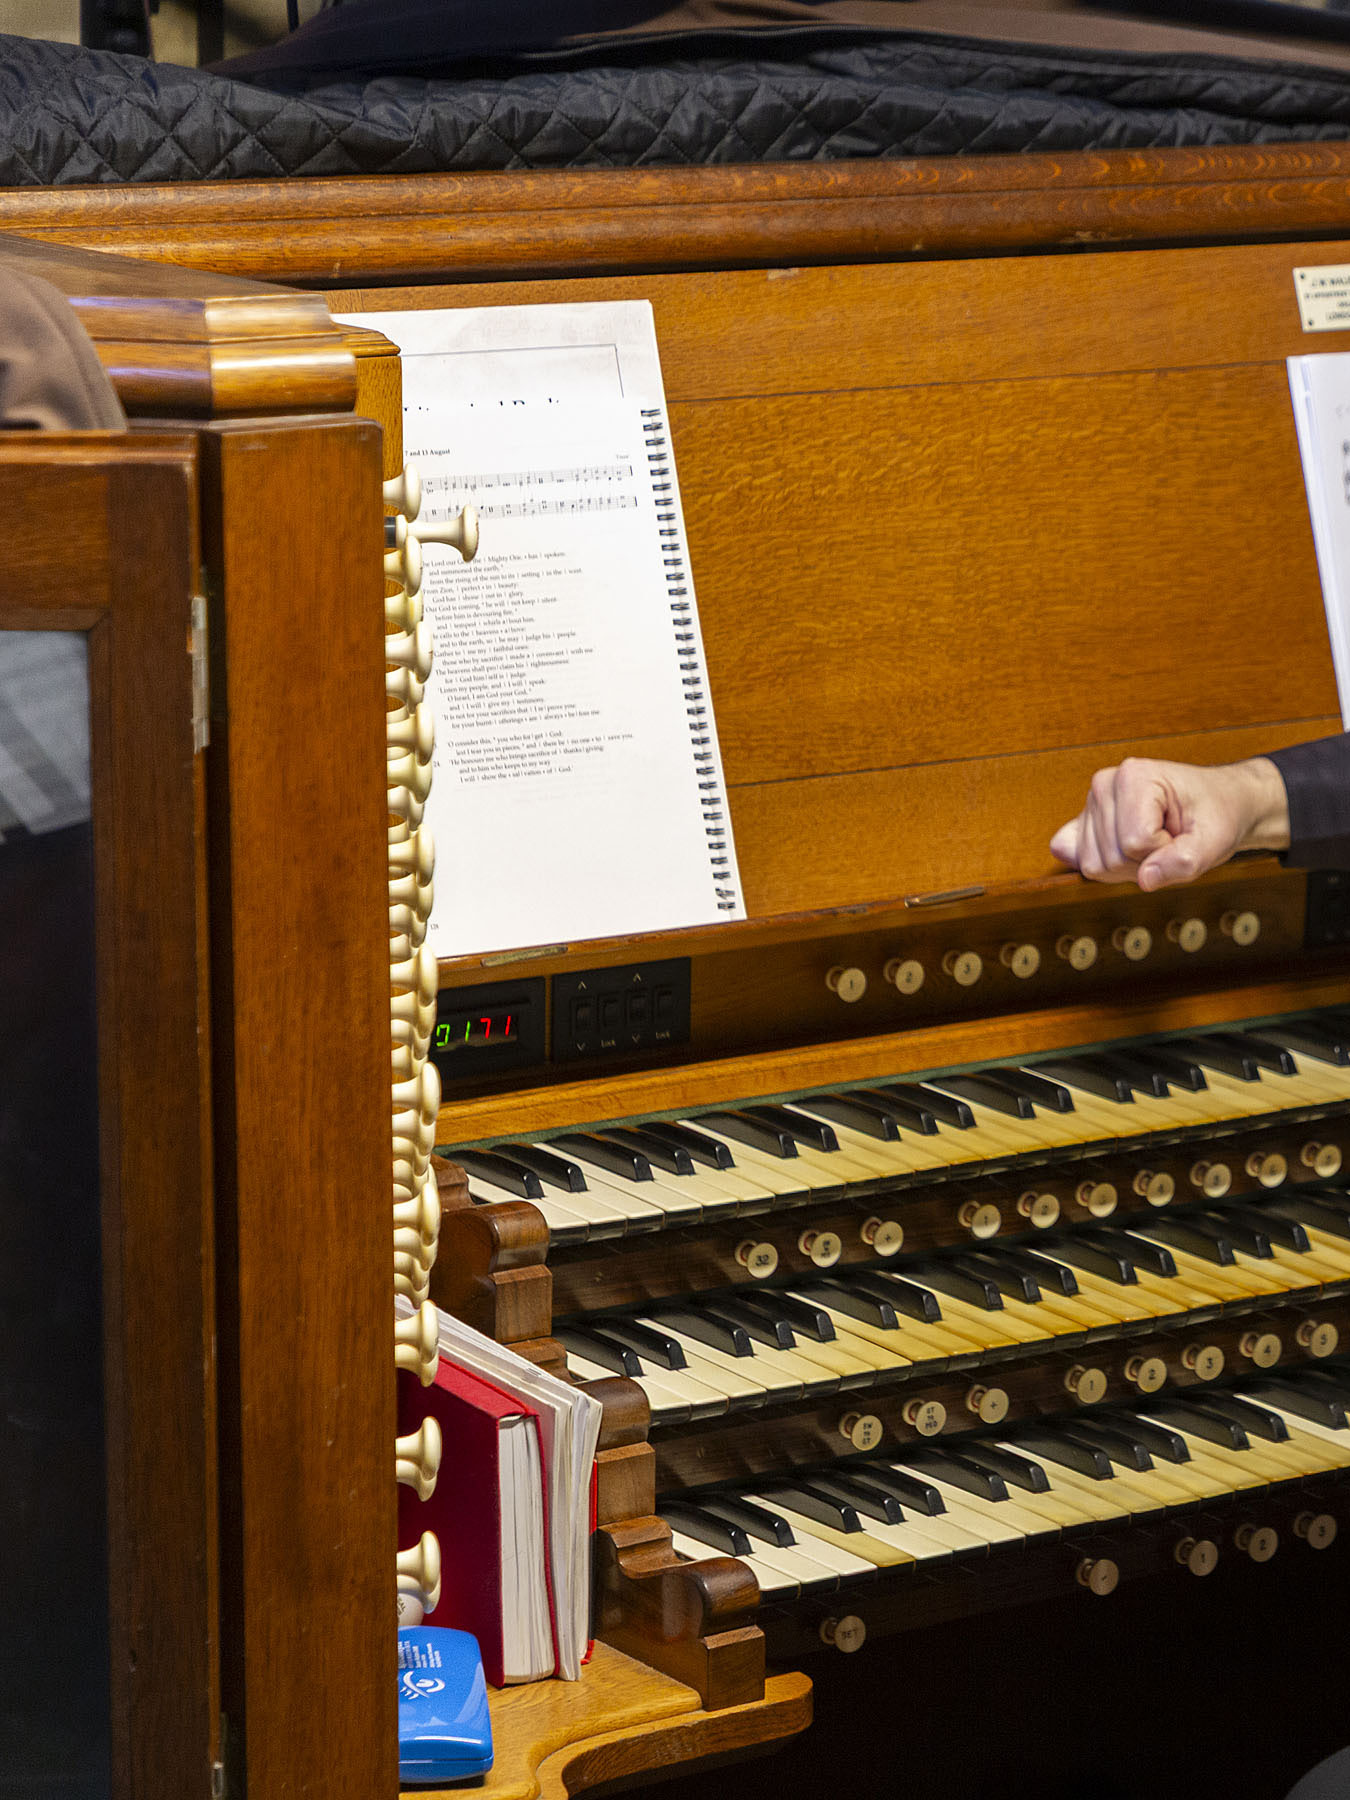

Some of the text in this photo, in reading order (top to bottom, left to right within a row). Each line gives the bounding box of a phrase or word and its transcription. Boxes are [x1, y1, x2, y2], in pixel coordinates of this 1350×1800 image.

[430, 448, 450, 457] August
[963, 962, 970, 974] 3
[756, 1254, 769, 1266] 32
[1206, 1358, 1212, 1369] 3
[1148, 1368, 1156, 1380] 2
[1318, 1526, 1325, 1537] 3
[1260, 1539, 1267, 1551] 2
